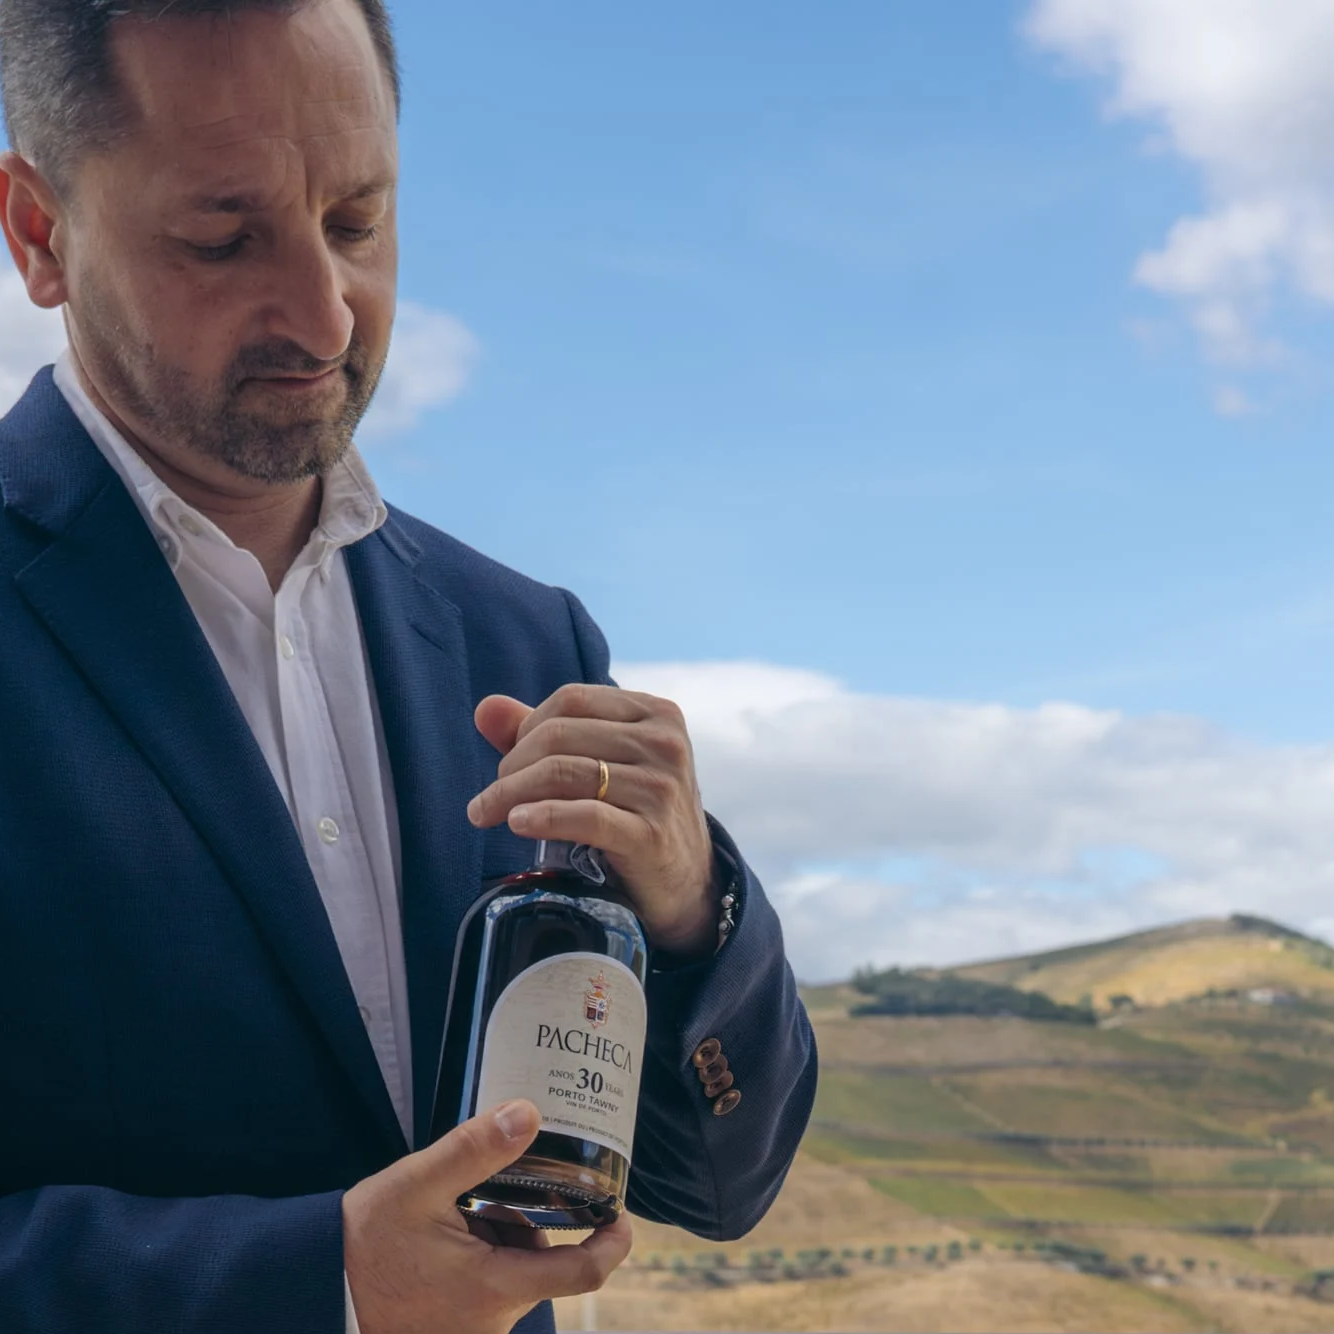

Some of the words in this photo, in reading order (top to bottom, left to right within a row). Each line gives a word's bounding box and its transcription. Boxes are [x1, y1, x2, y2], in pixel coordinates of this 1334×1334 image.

[536, 1024, 632, 1074] PACHECA
[548, 1069, 575, 1080] ANOS
[576, 1067, 604, 1094] 30
[548, 1087, 586, 1102] PORTO
[589, 1096, 619, 1113] TAWNY
